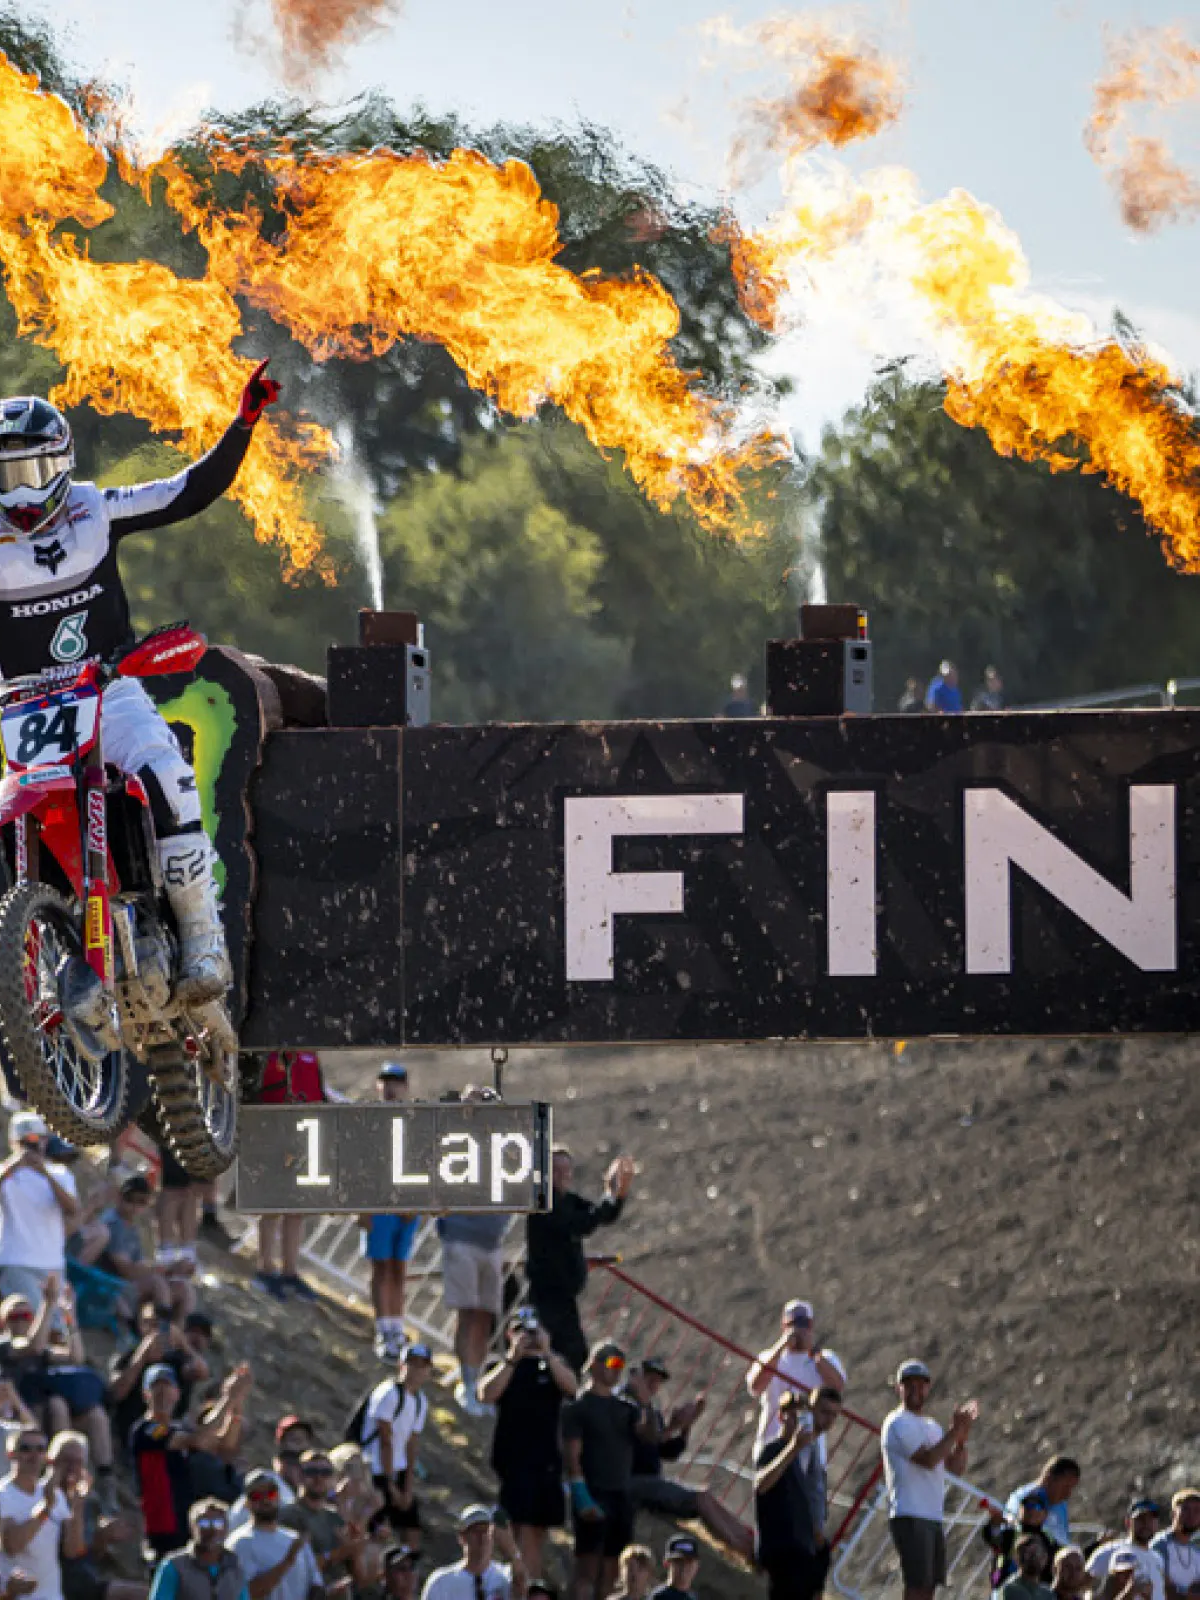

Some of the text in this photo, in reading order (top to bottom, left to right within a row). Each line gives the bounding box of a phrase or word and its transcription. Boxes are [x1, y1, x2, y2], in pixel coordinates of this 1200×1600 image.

[10, 583, 104, 618] HONDA
[17, 705, 81, 763] 84
[563, 784, 1178, 982] FIN
[296, 1116, 533, 1203] 1 Lap
